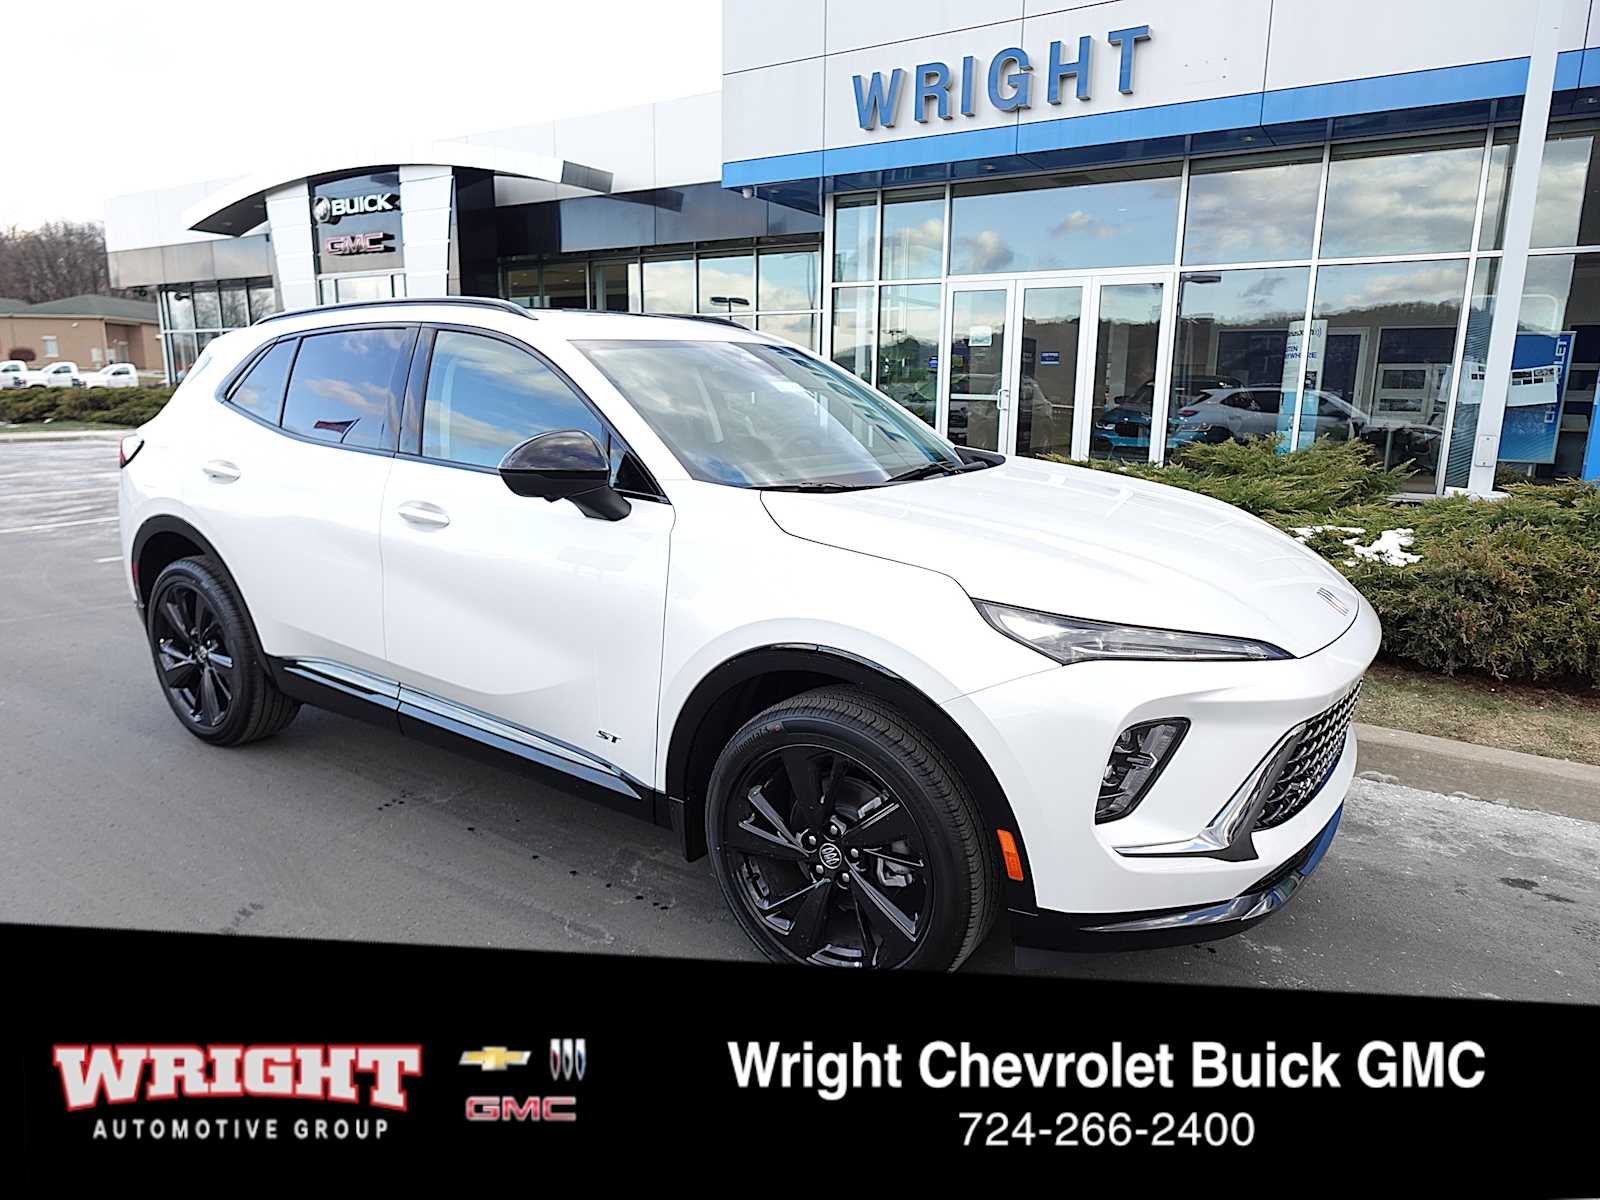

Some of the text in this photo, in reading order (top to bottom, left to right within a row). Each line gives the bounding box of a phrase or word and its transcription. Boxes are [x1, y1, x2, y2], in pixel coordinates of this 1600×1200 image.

[852, 25, 1152, 131] WRIGHT
[331, 193, 393, 216] BUICK
[326, 232, 385, 255] GMC
[595, 730, 622, 744] ST
